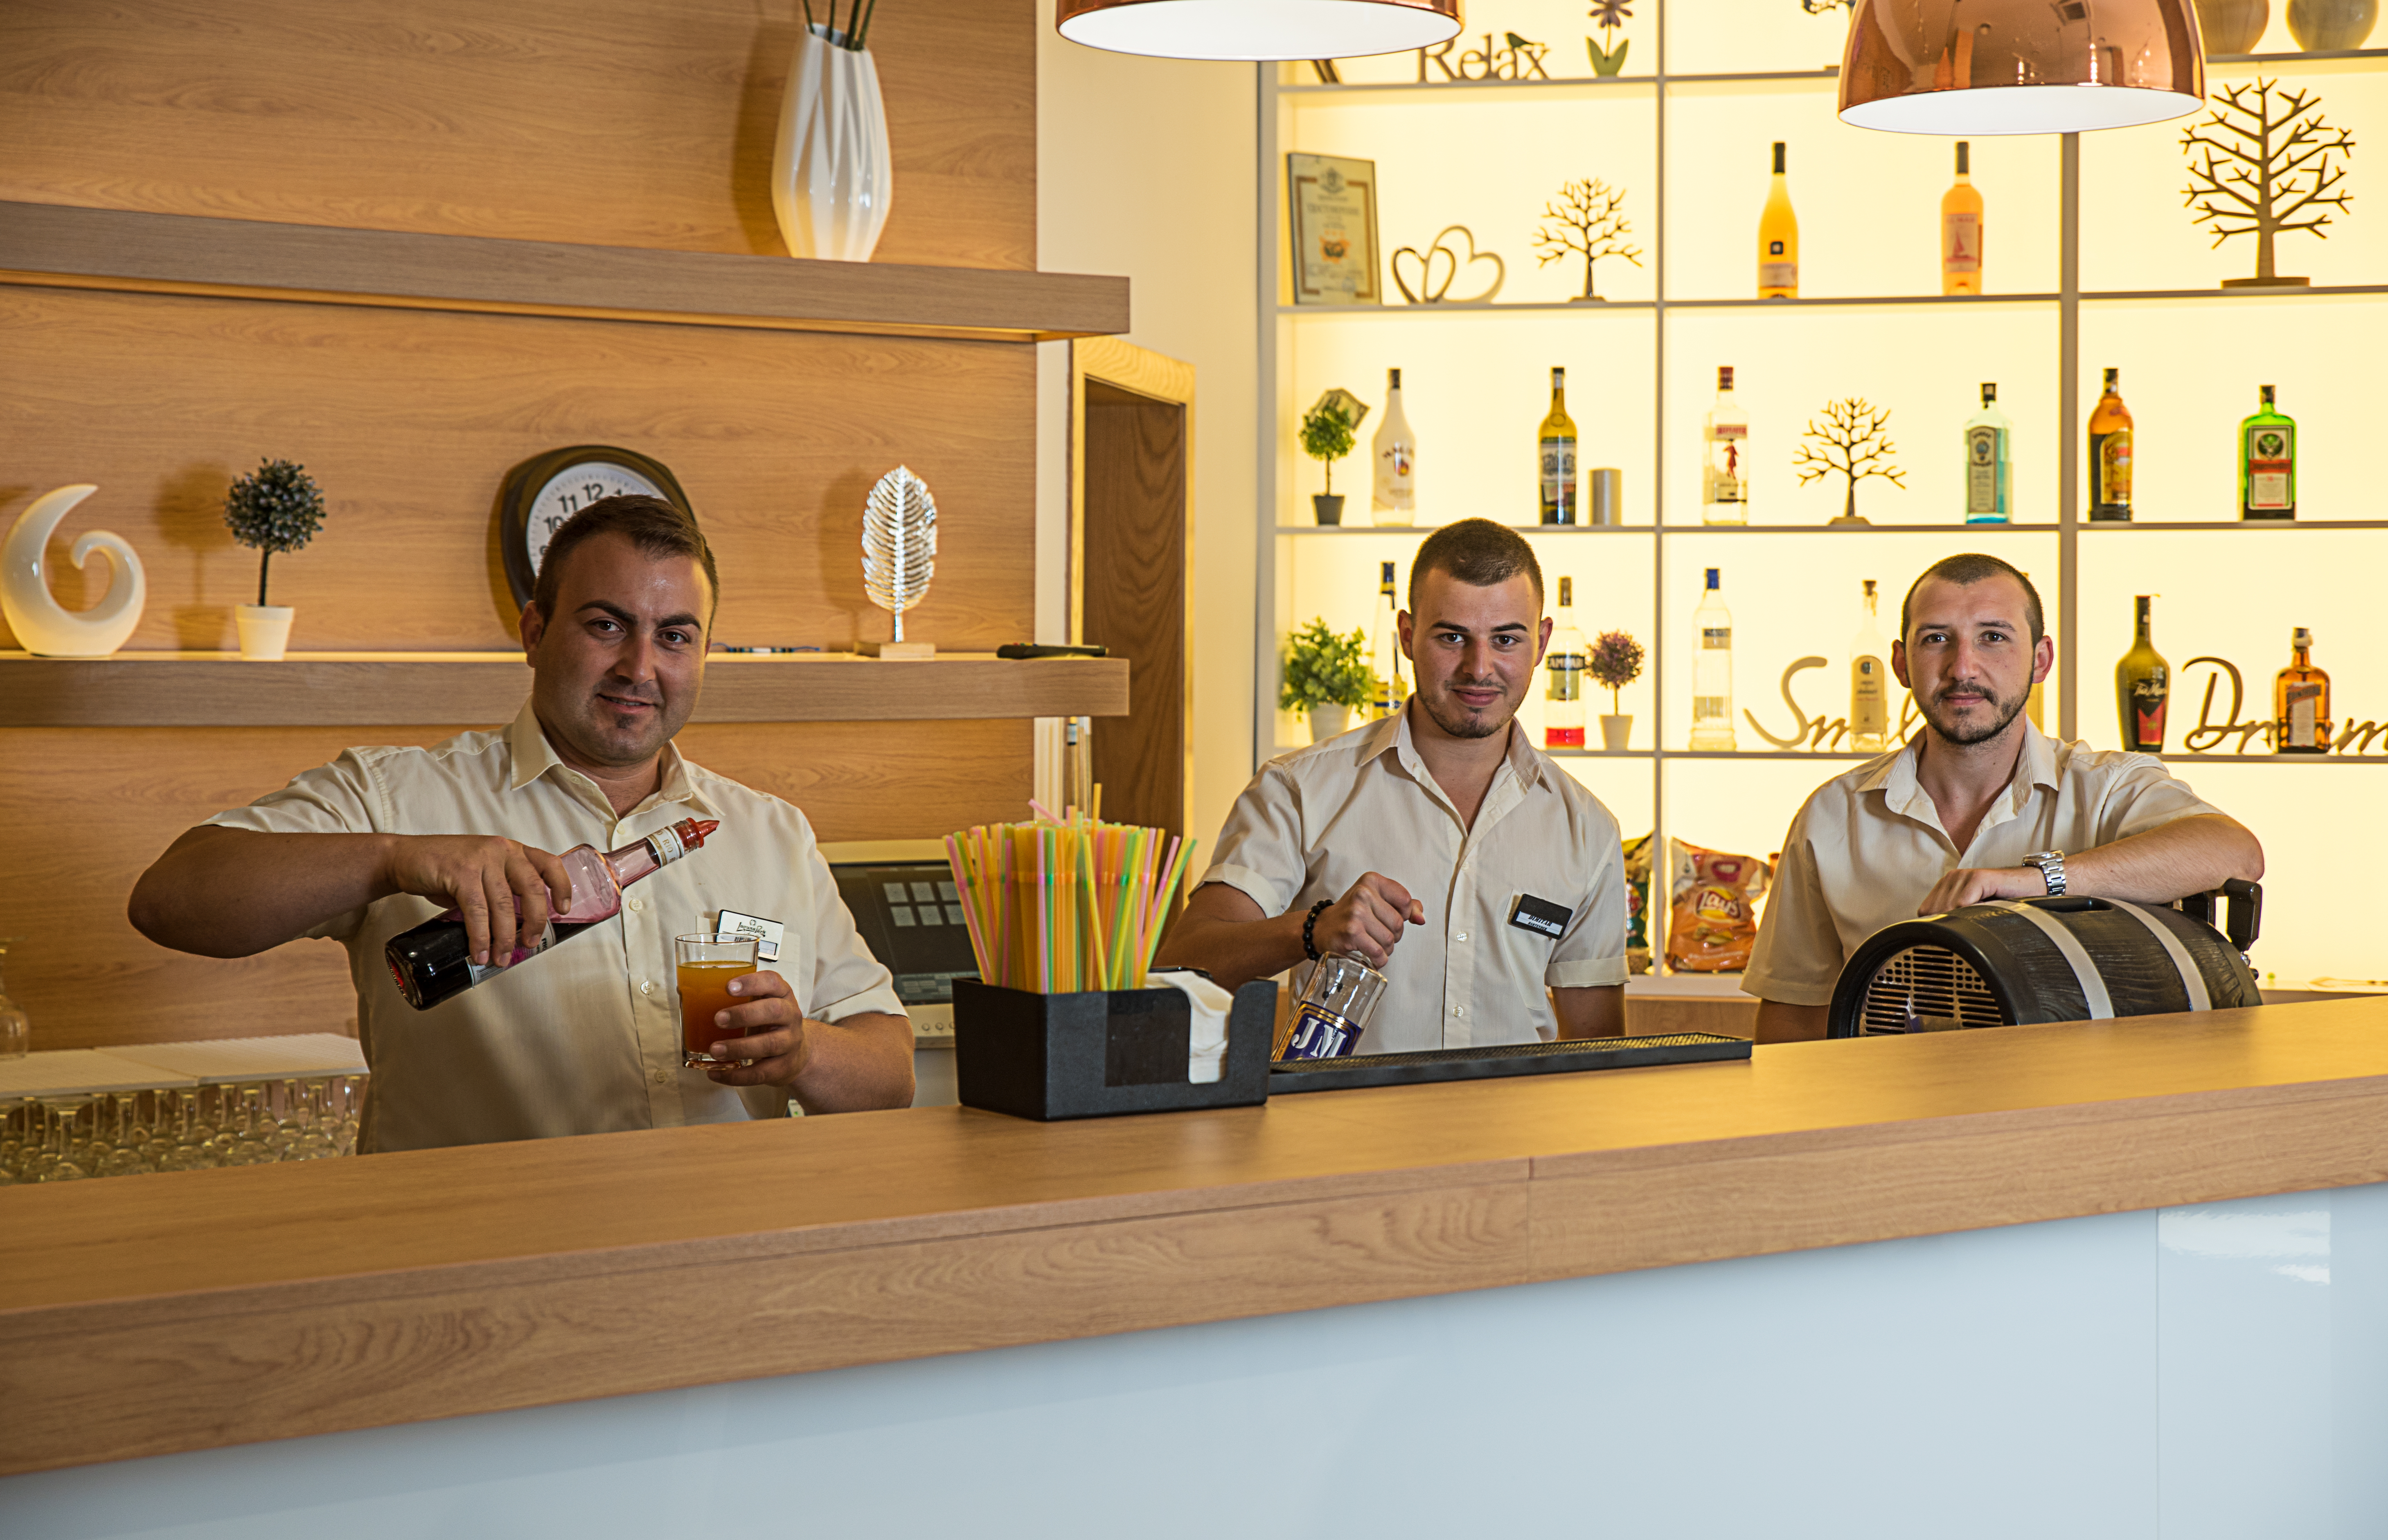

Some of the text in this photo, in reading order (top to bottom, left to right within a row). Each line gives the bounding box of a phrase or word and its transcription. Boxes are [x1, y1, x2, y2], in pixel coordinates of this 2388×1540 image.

[1418, 33, 1550, 83] Relax
[582, 483, 603, 502] 12
[558, 495, 577, 513] 11
[662, 838, 674, 853] RIO
[1527, 921, 1548, 931] BARTENDER
[1528, 914, 1552, 927] DIMITAR
